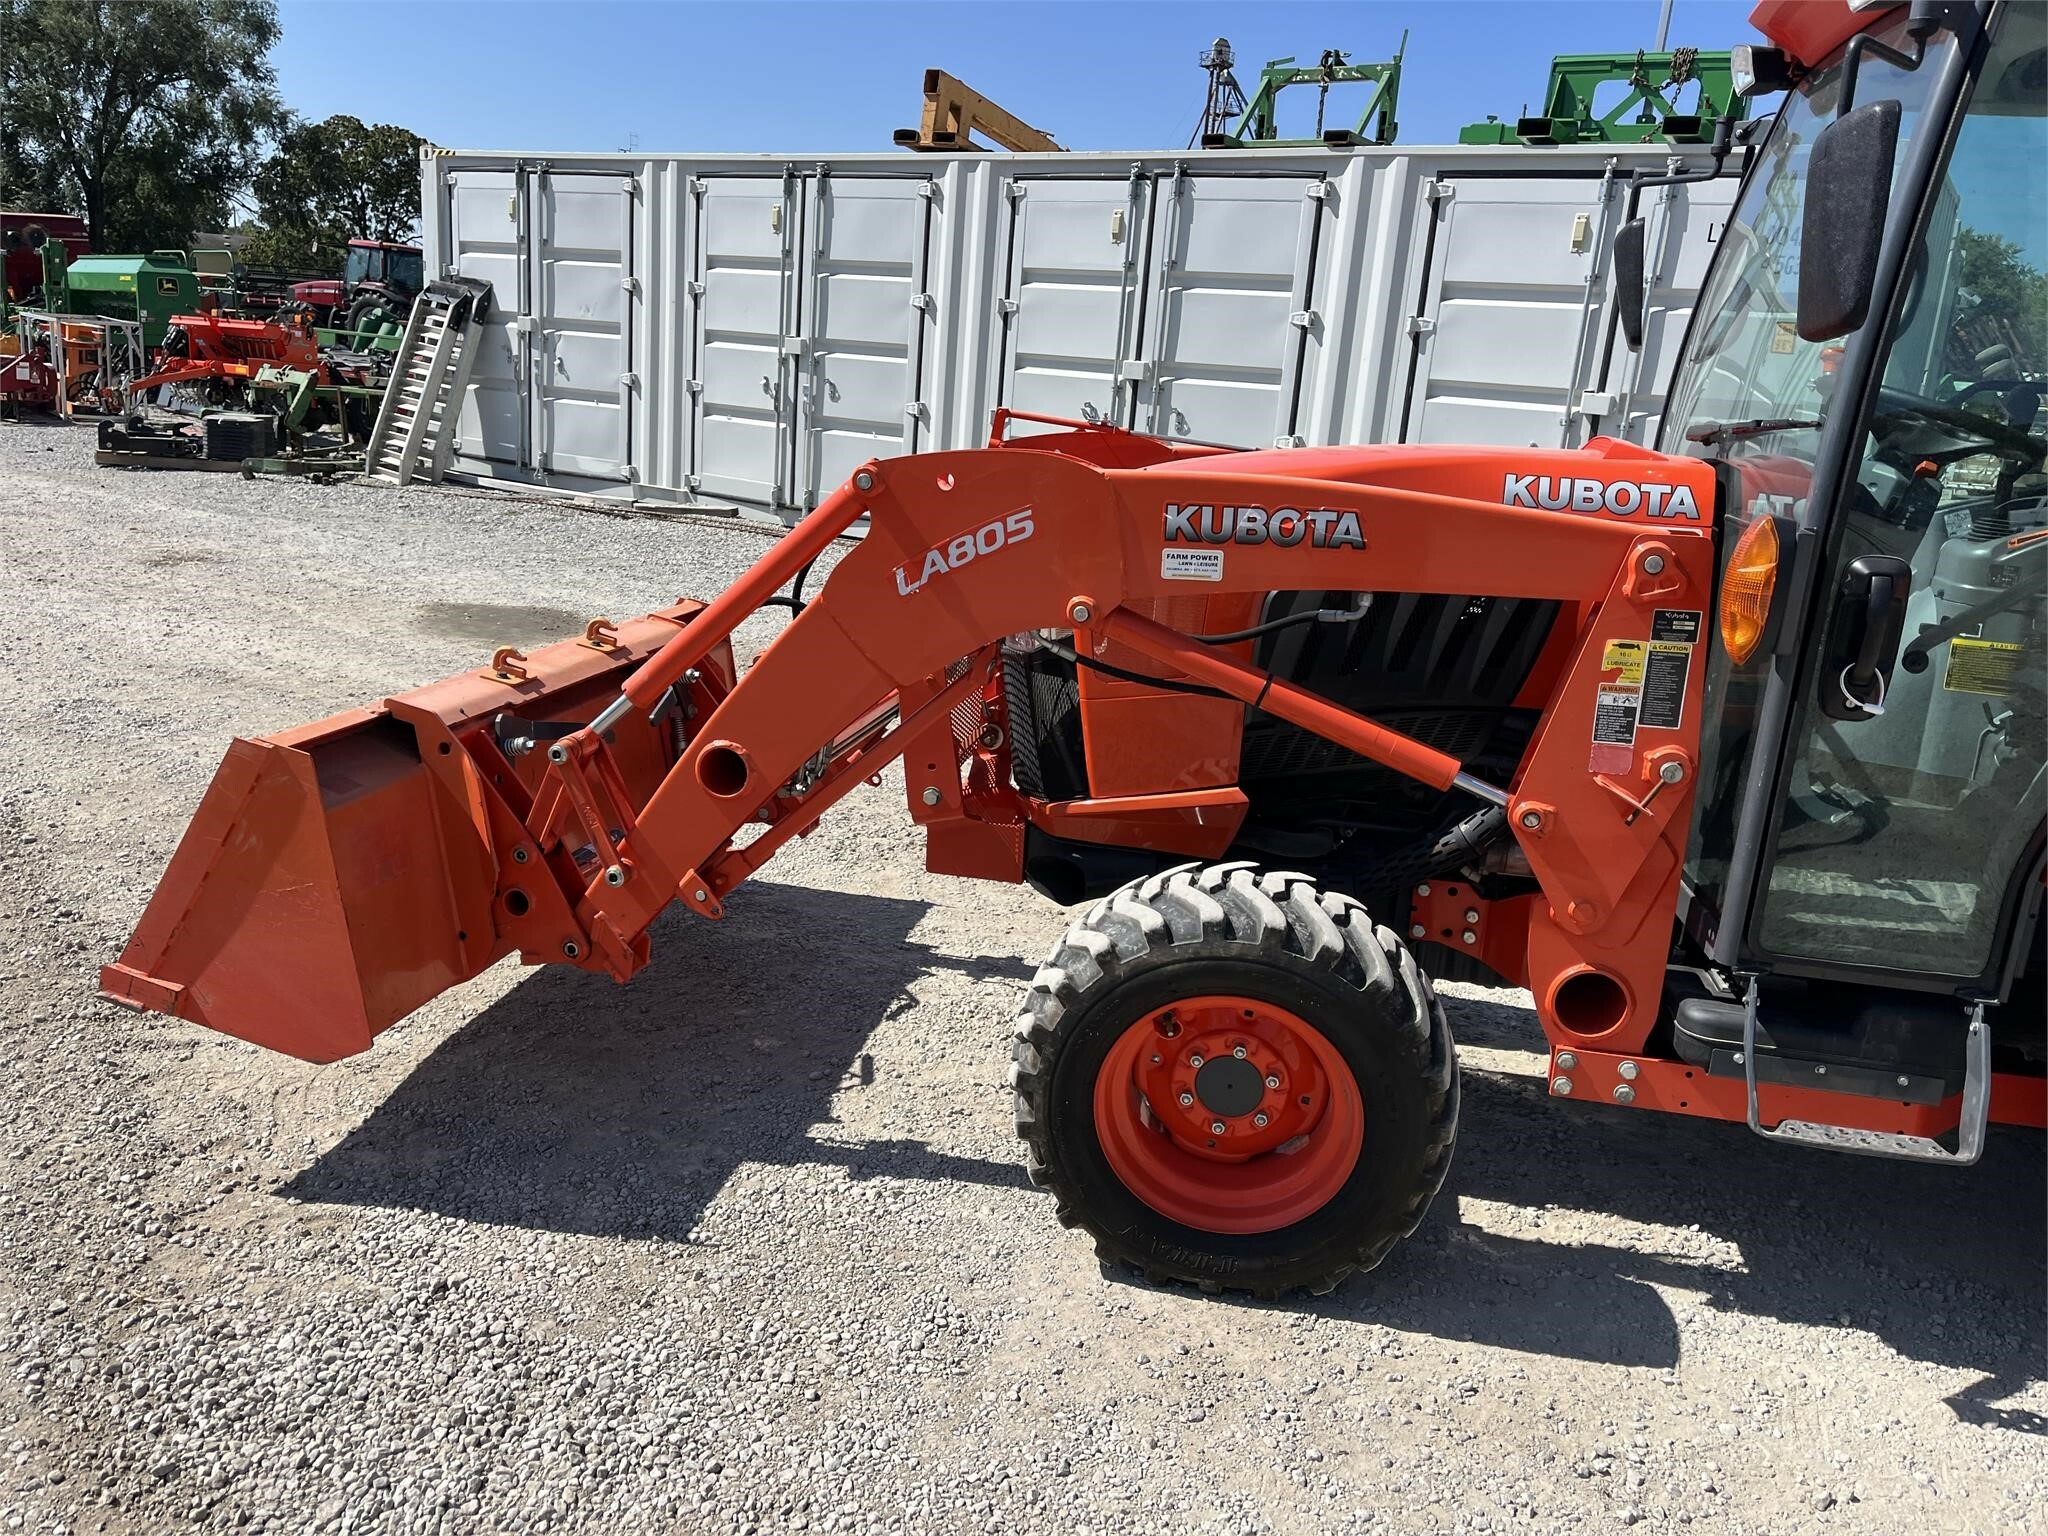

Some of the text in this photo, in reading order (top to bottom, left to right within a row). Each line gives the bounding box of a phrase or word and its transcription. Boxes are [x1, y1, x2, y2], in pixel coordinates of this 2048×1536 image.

[1503, 472, 1701, 520] KUBOTA
[1164, 503, 1367, 550] KUBOTA
[895, 509, 1035, 596] LA805
[1190, 554, 1219, 562] POWER
[1658, 644, 1689, 652] CAUTION
[1606, 660, 1641, 668] LUBRICATE
[1608, 685, 1638, 694] WARNING
